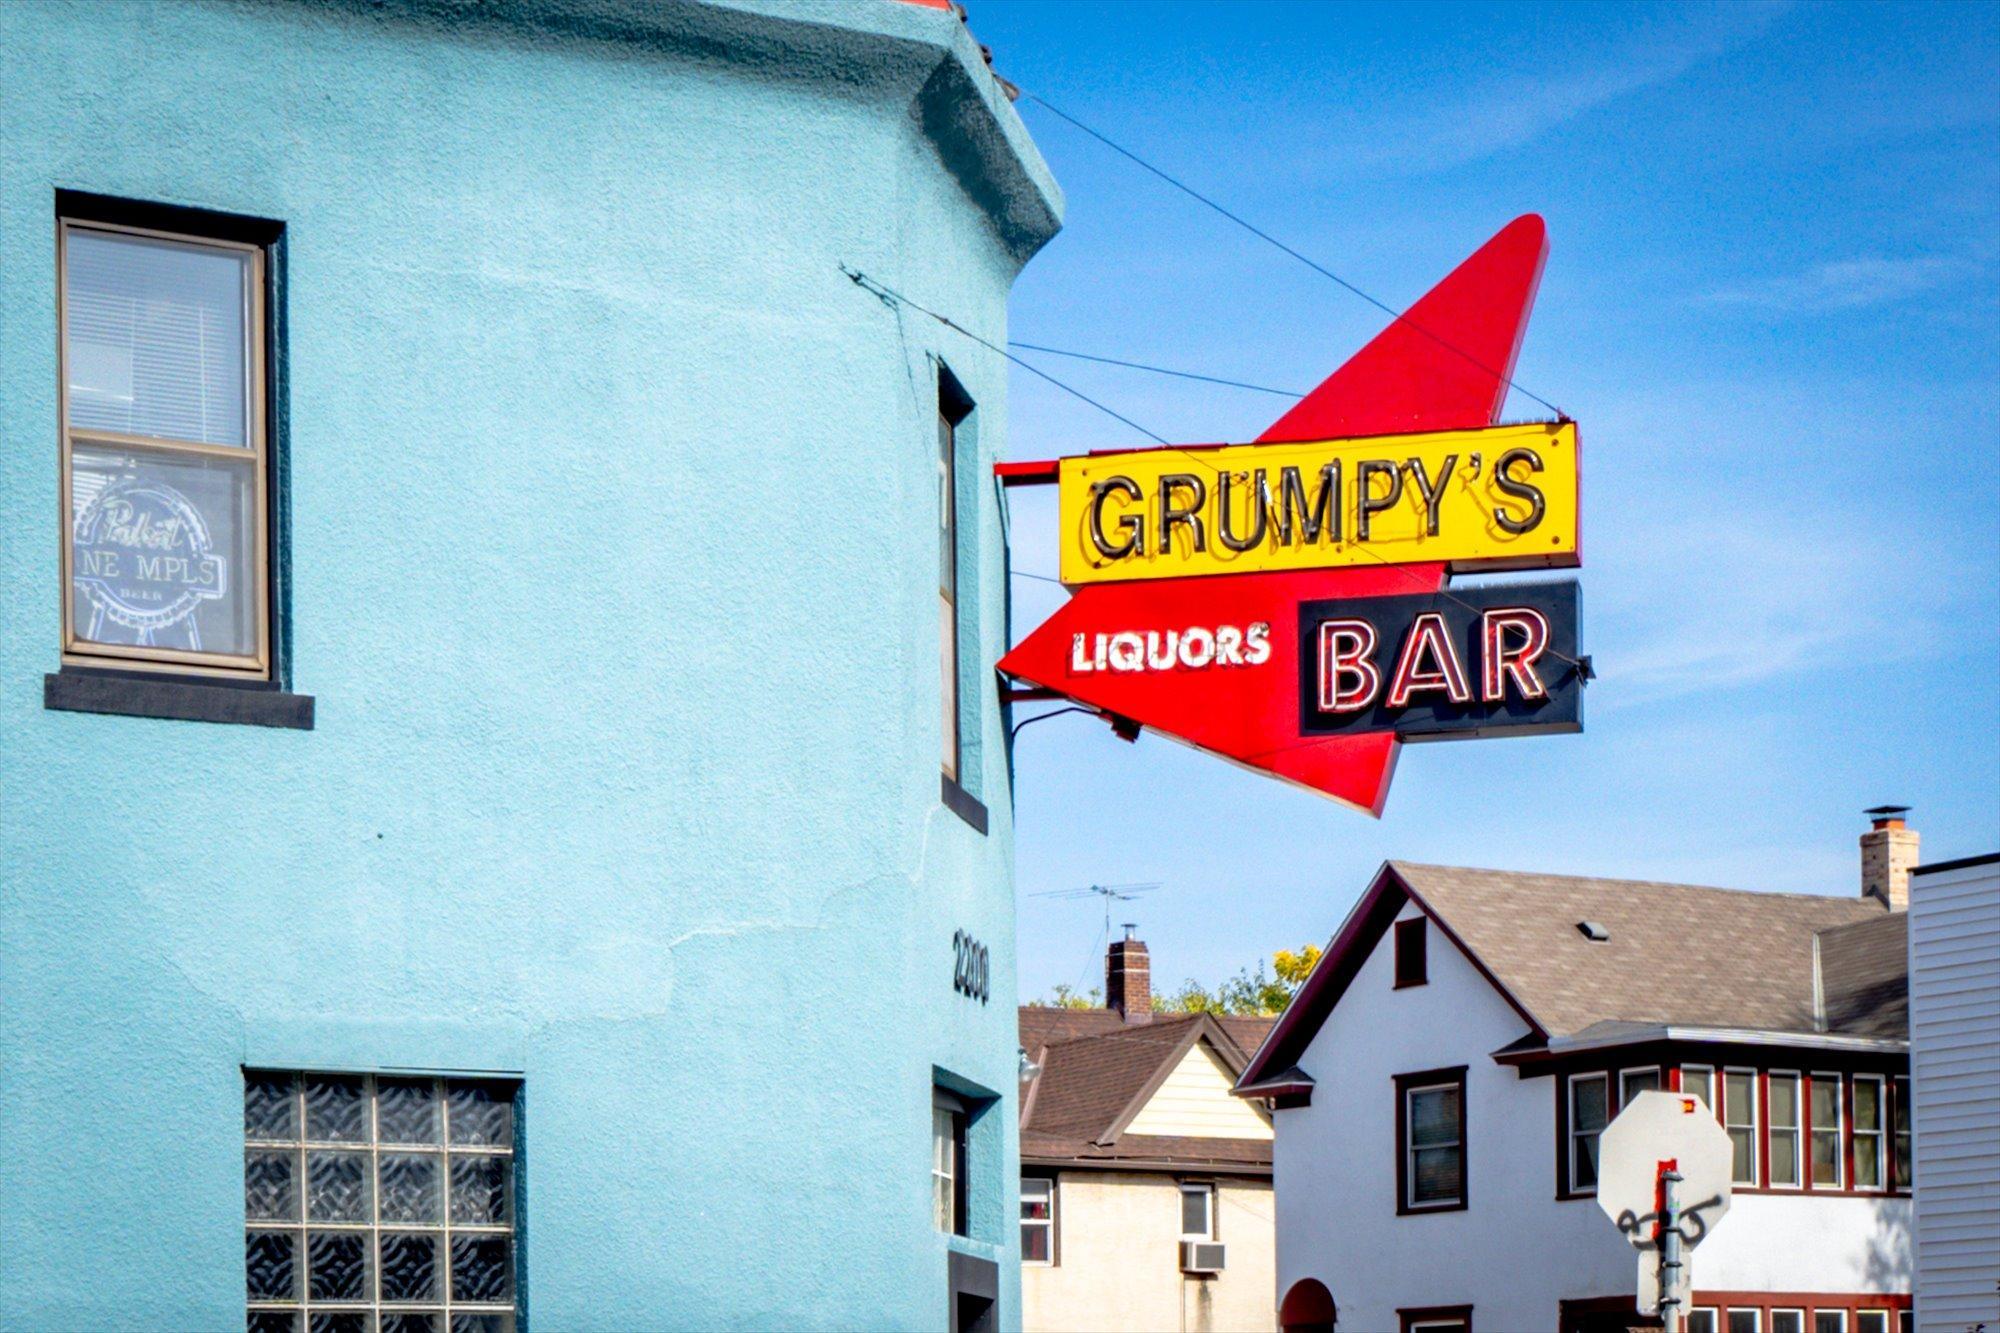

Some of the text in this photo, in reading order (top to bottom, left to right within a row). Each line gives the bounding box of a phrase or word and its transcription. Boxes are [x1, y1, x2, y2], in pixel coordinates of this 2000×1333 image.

[1089, 446, 1546, 560] GRUMPY'S
[81, 550, 215, 585] NE MPLS
[119, 587, 162, 601] BEER
[1071, 621, 1271, 672] LIQUORS
[1316, 606, 1550, 713] BAR
[953, 927, 989, 1007] 2200
